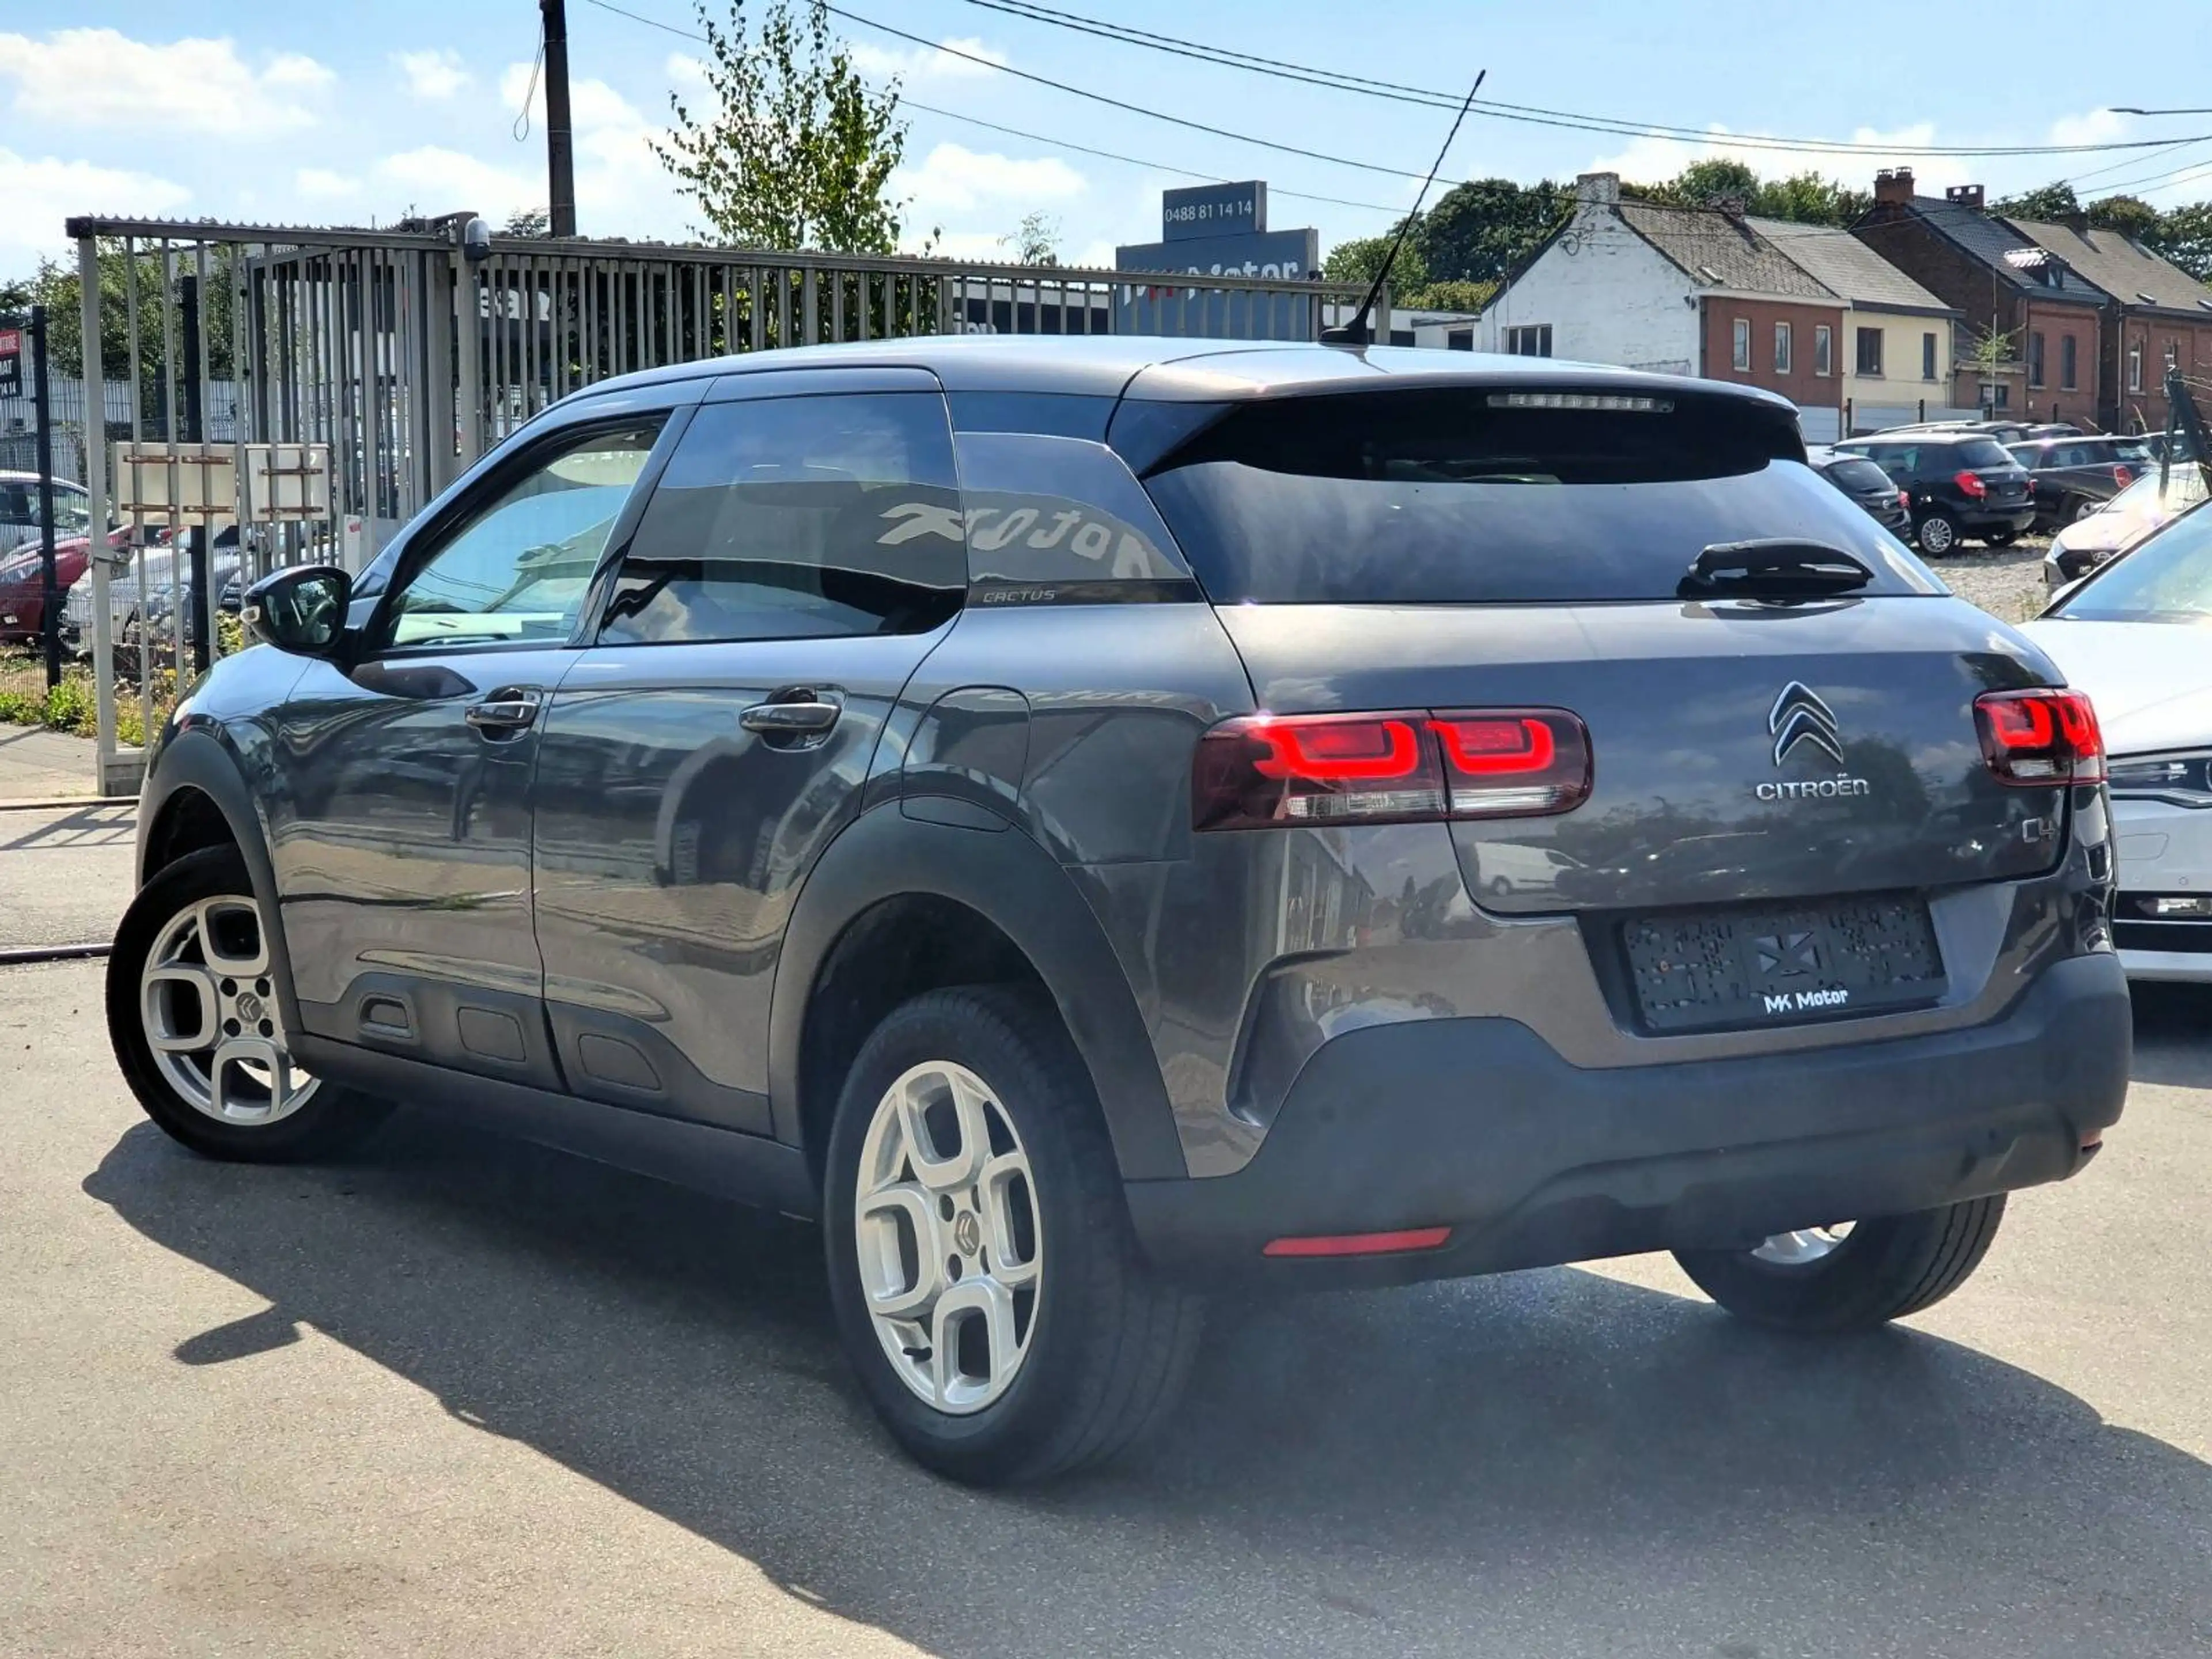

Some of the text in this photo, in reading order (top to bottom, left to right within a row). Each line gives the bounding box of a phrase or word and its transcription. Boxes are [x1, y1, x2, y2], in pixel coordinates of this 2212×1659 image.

[1165, 199, 1252, 222] 0488 81 14 14
[983, 590, 1056, 603] CACTUS
[2022, 818, 2055, 843] C4
[1764, 984, 1849, 1014] MK Motor
